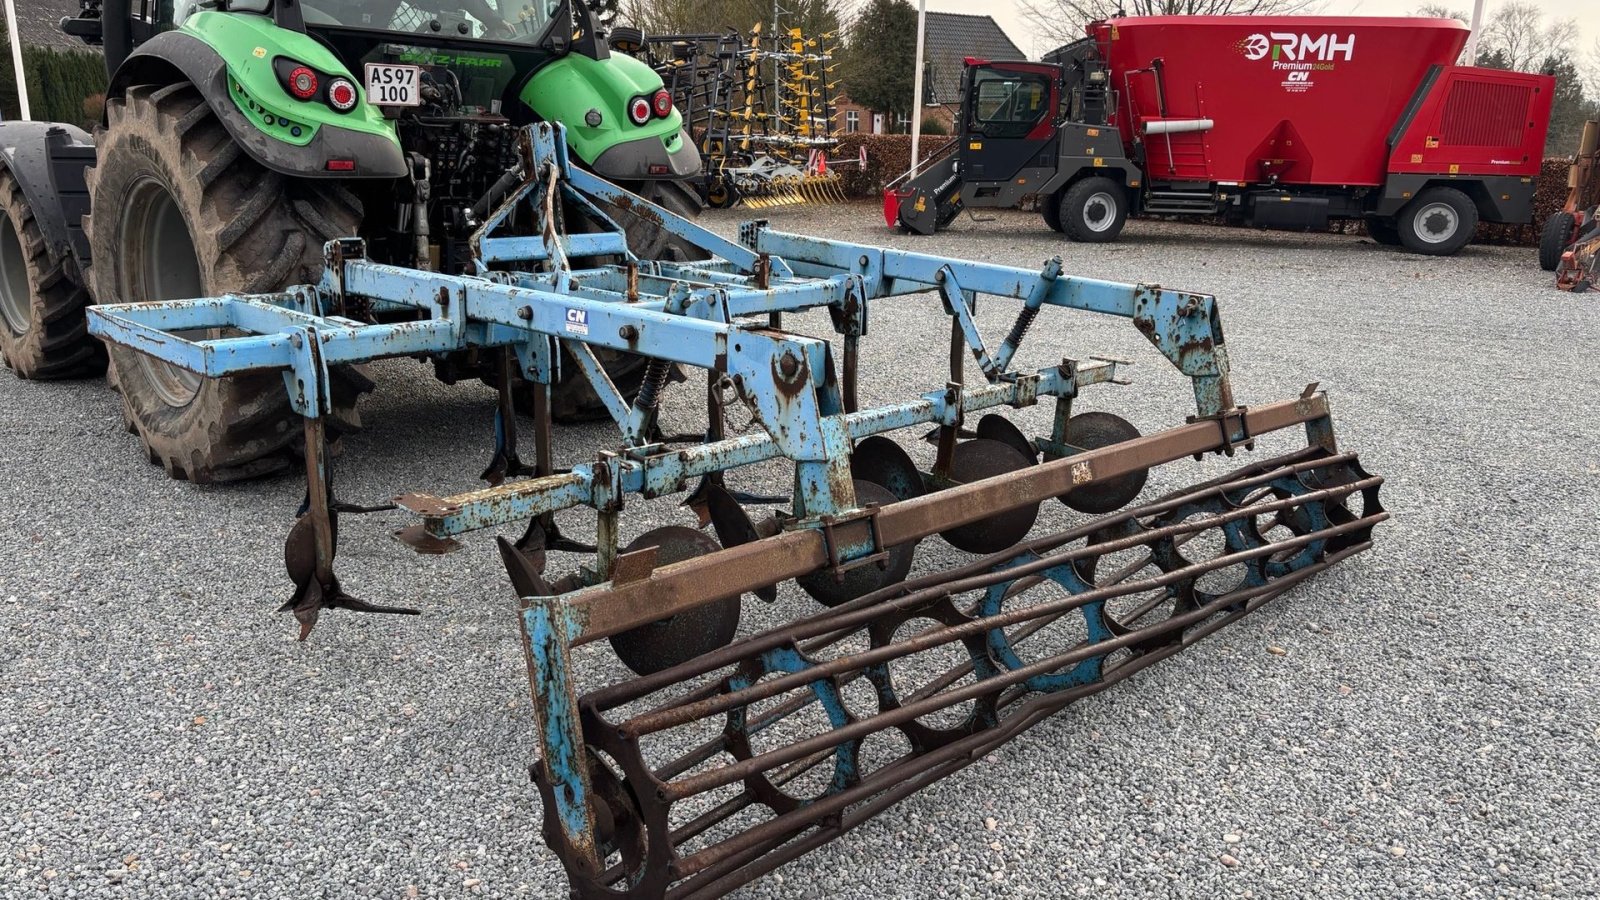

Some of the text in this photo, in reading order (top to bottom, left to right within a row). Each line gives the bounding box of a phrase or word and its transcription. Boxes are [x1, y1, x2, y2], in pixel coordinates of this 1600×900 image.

[1270, 31, 1355, 61] RMH
[1287, 71, 1310, 81] CN
[380, 86, 408, 102] 100
[567, 308, 586, 323] CN
